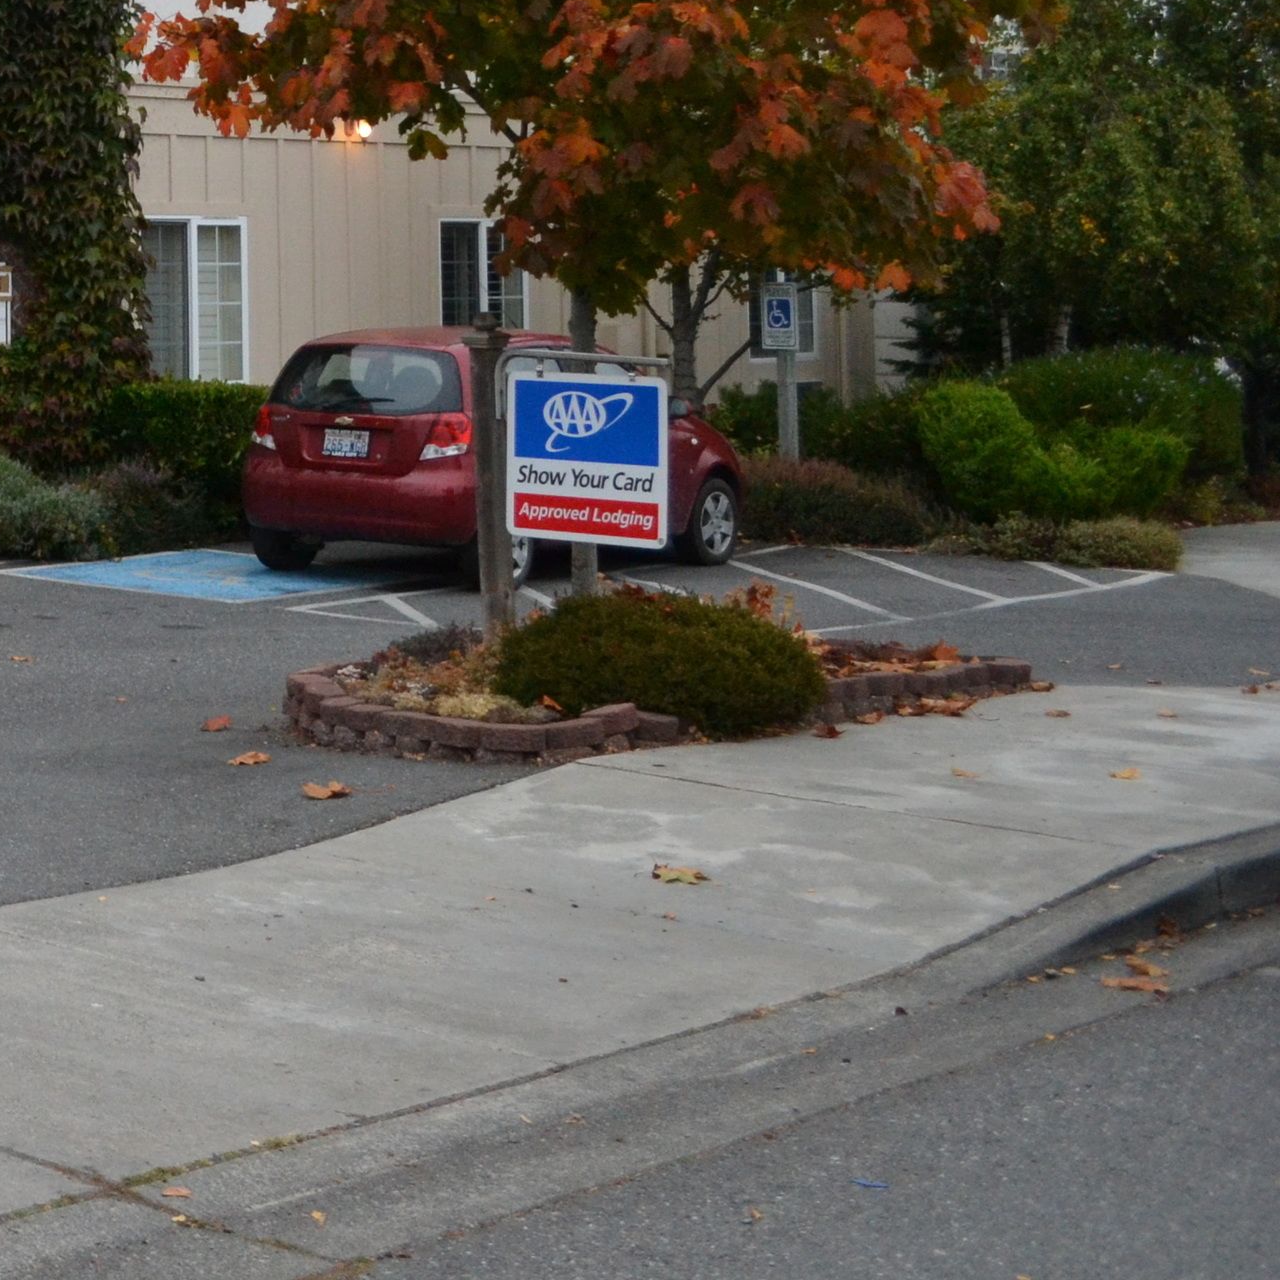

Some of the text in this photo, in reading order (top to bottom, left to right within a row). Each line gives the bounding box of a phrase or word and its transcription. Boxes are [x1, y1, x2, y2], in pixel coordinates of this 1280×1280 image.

[552, 392, 598, 436] AAA
[517, 465, 654, 492] Show Your Card
[519, 502, 653, 529] Approved Lodging
